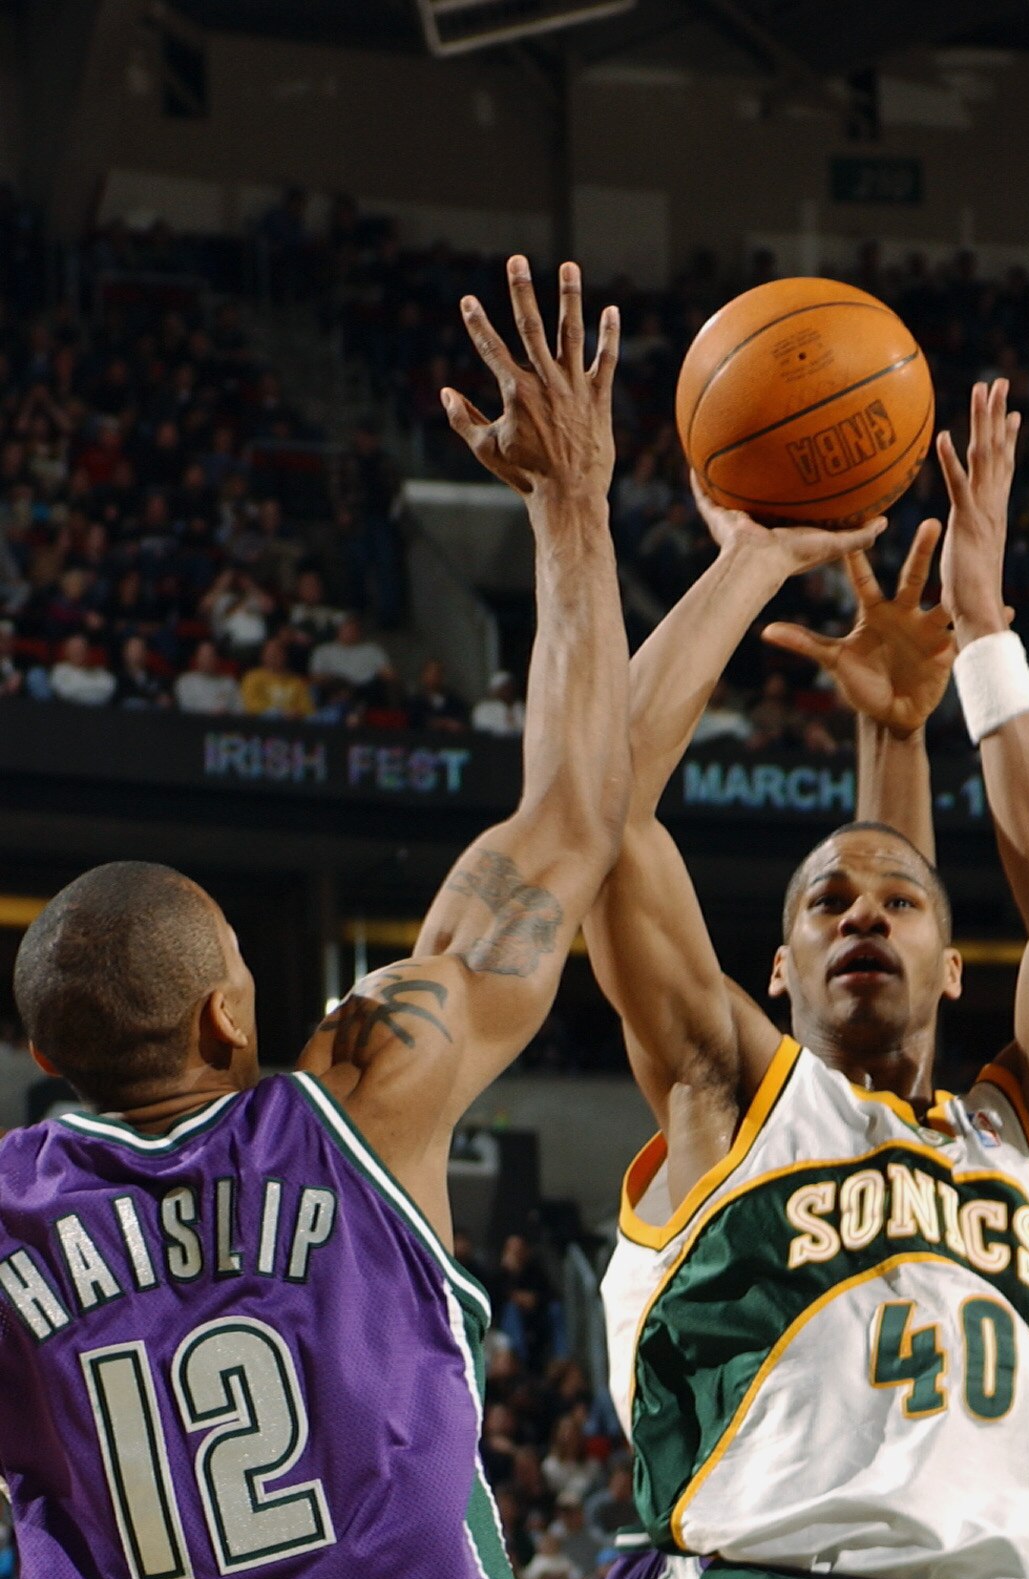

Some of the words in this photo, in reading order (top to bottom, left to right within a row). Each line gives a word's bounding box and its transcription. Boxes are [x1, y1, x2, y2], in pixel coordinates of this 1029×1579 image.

[786, 408, 877, 486] NBA
[203, 730, 328, 786] IRISH
[346, 742, 472, 796] FEST
[681, 758, 855, 813] MARCH
[0, 1176, 339, 1346] HAISLIP
[870, 1294, 1017, 1421] 40
